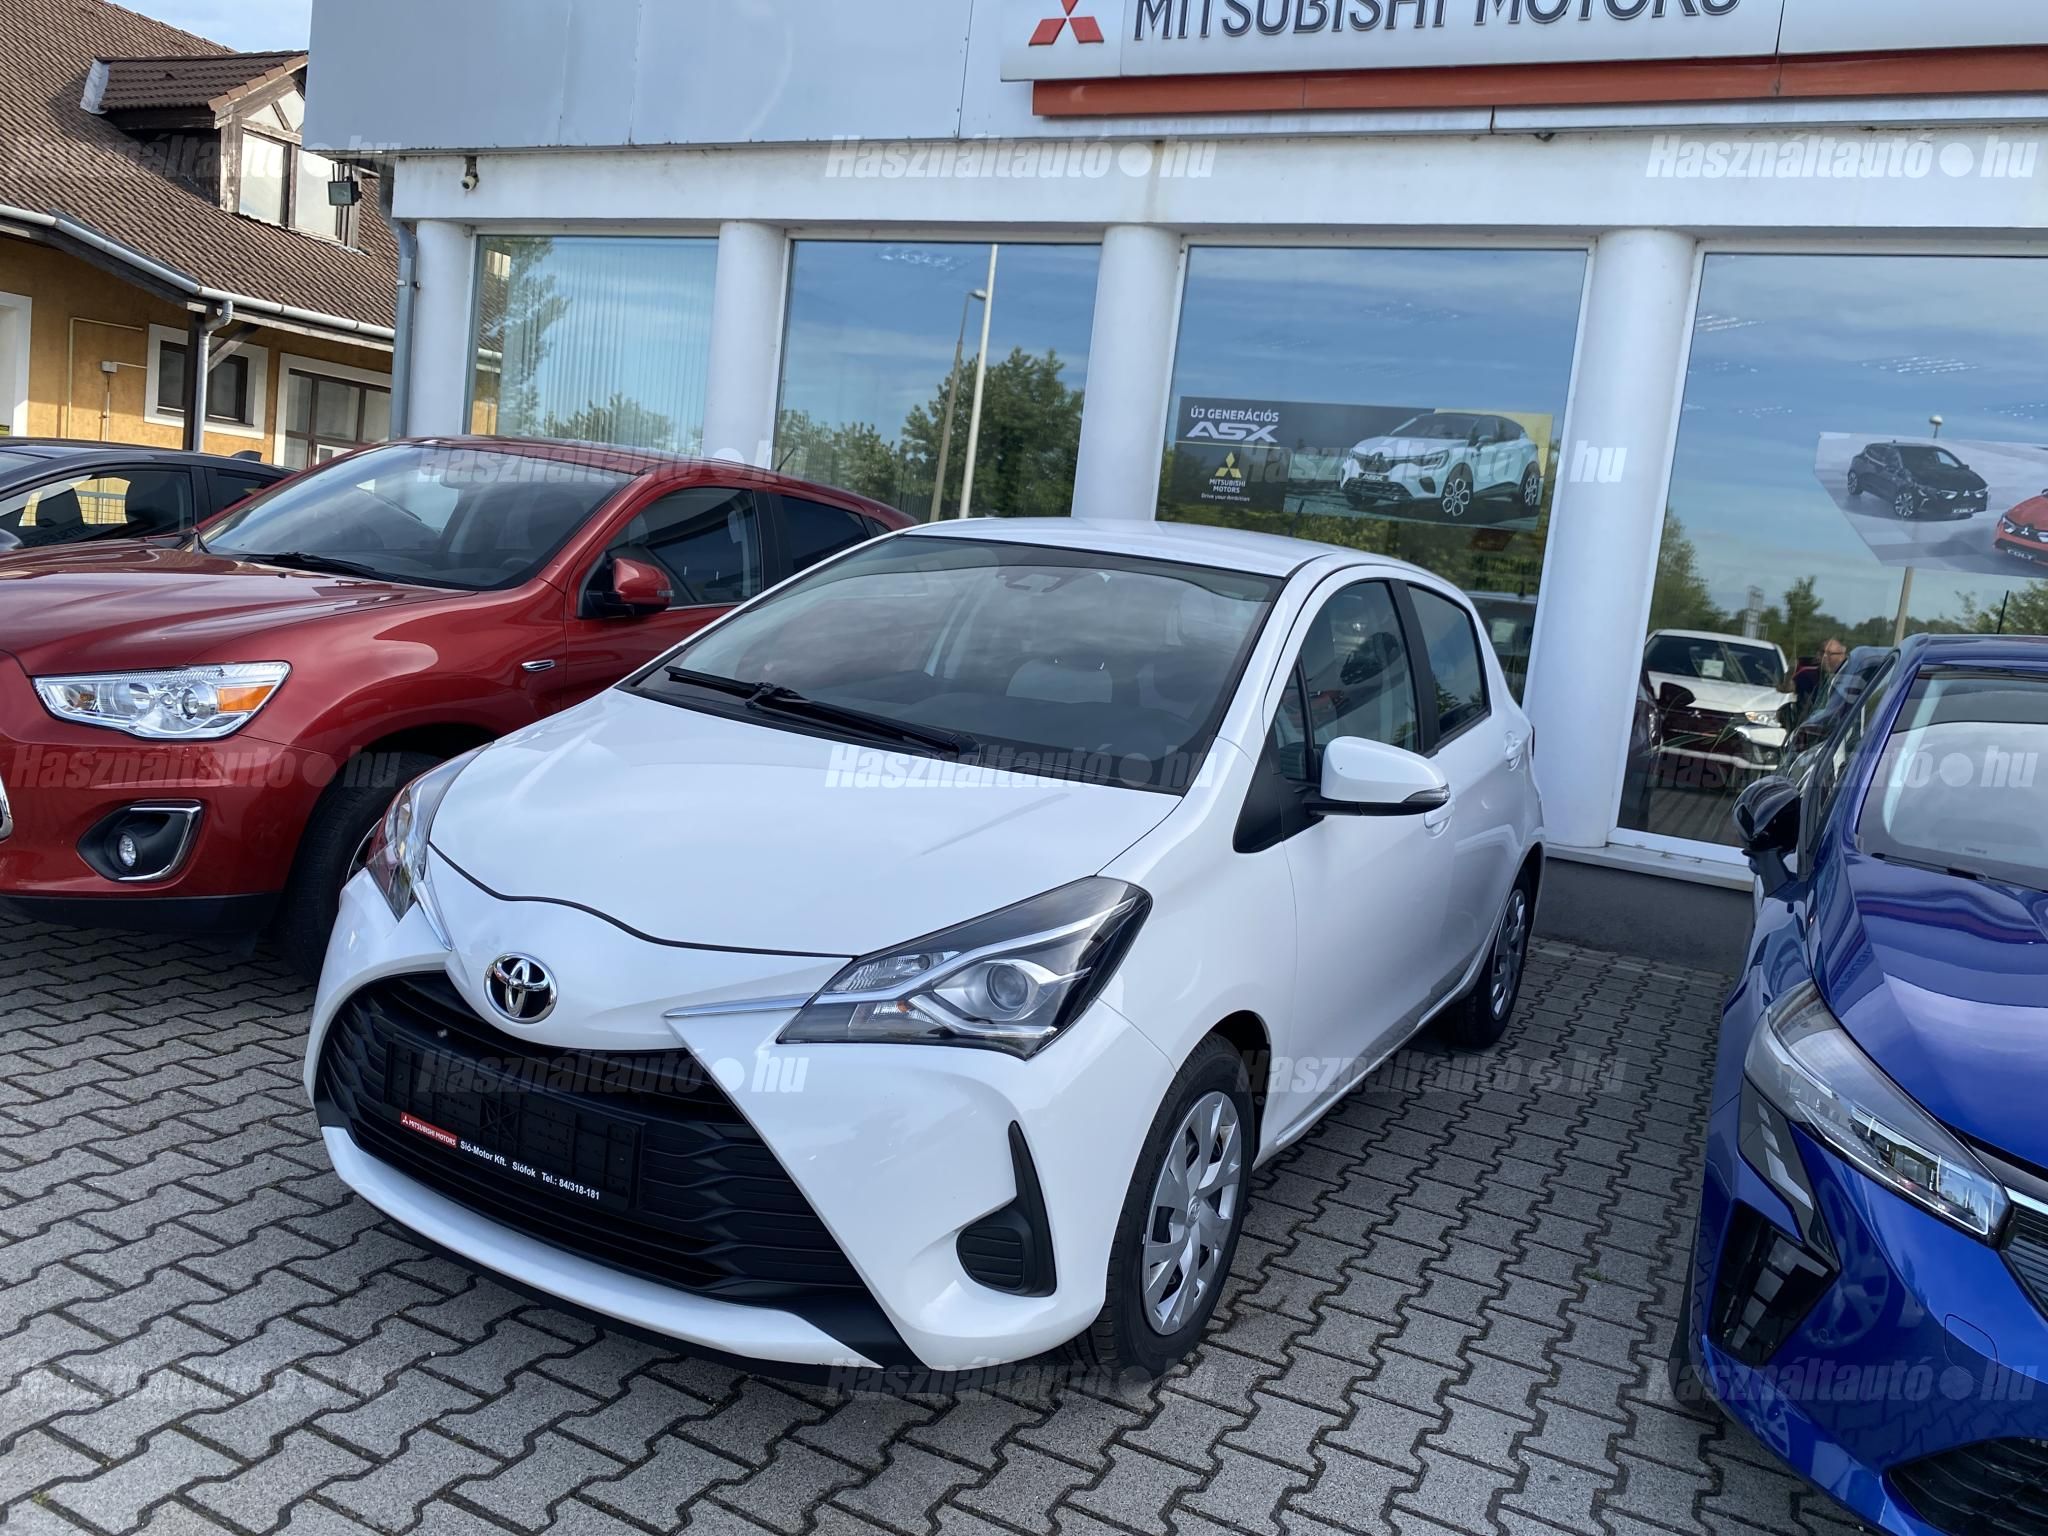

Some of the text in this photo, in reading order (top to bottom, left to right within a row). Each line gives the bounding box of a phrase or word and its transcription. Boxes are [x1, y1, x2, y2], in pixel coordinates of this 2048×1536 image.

[1190, 405, 1280, 422] ÚJ GENERÁCIÓS
[1185, 421, 1278, 443] ASX
[1209, 478, 1246, 487] MITSUBISHI
[1213, 485, 1240, 493] MOTORS
[435, 1131, 456, 1146] MOTORS
[460, 1140, 600, 1200] Sió-Motor Kft. Siófok Tel.: 84/318-181
